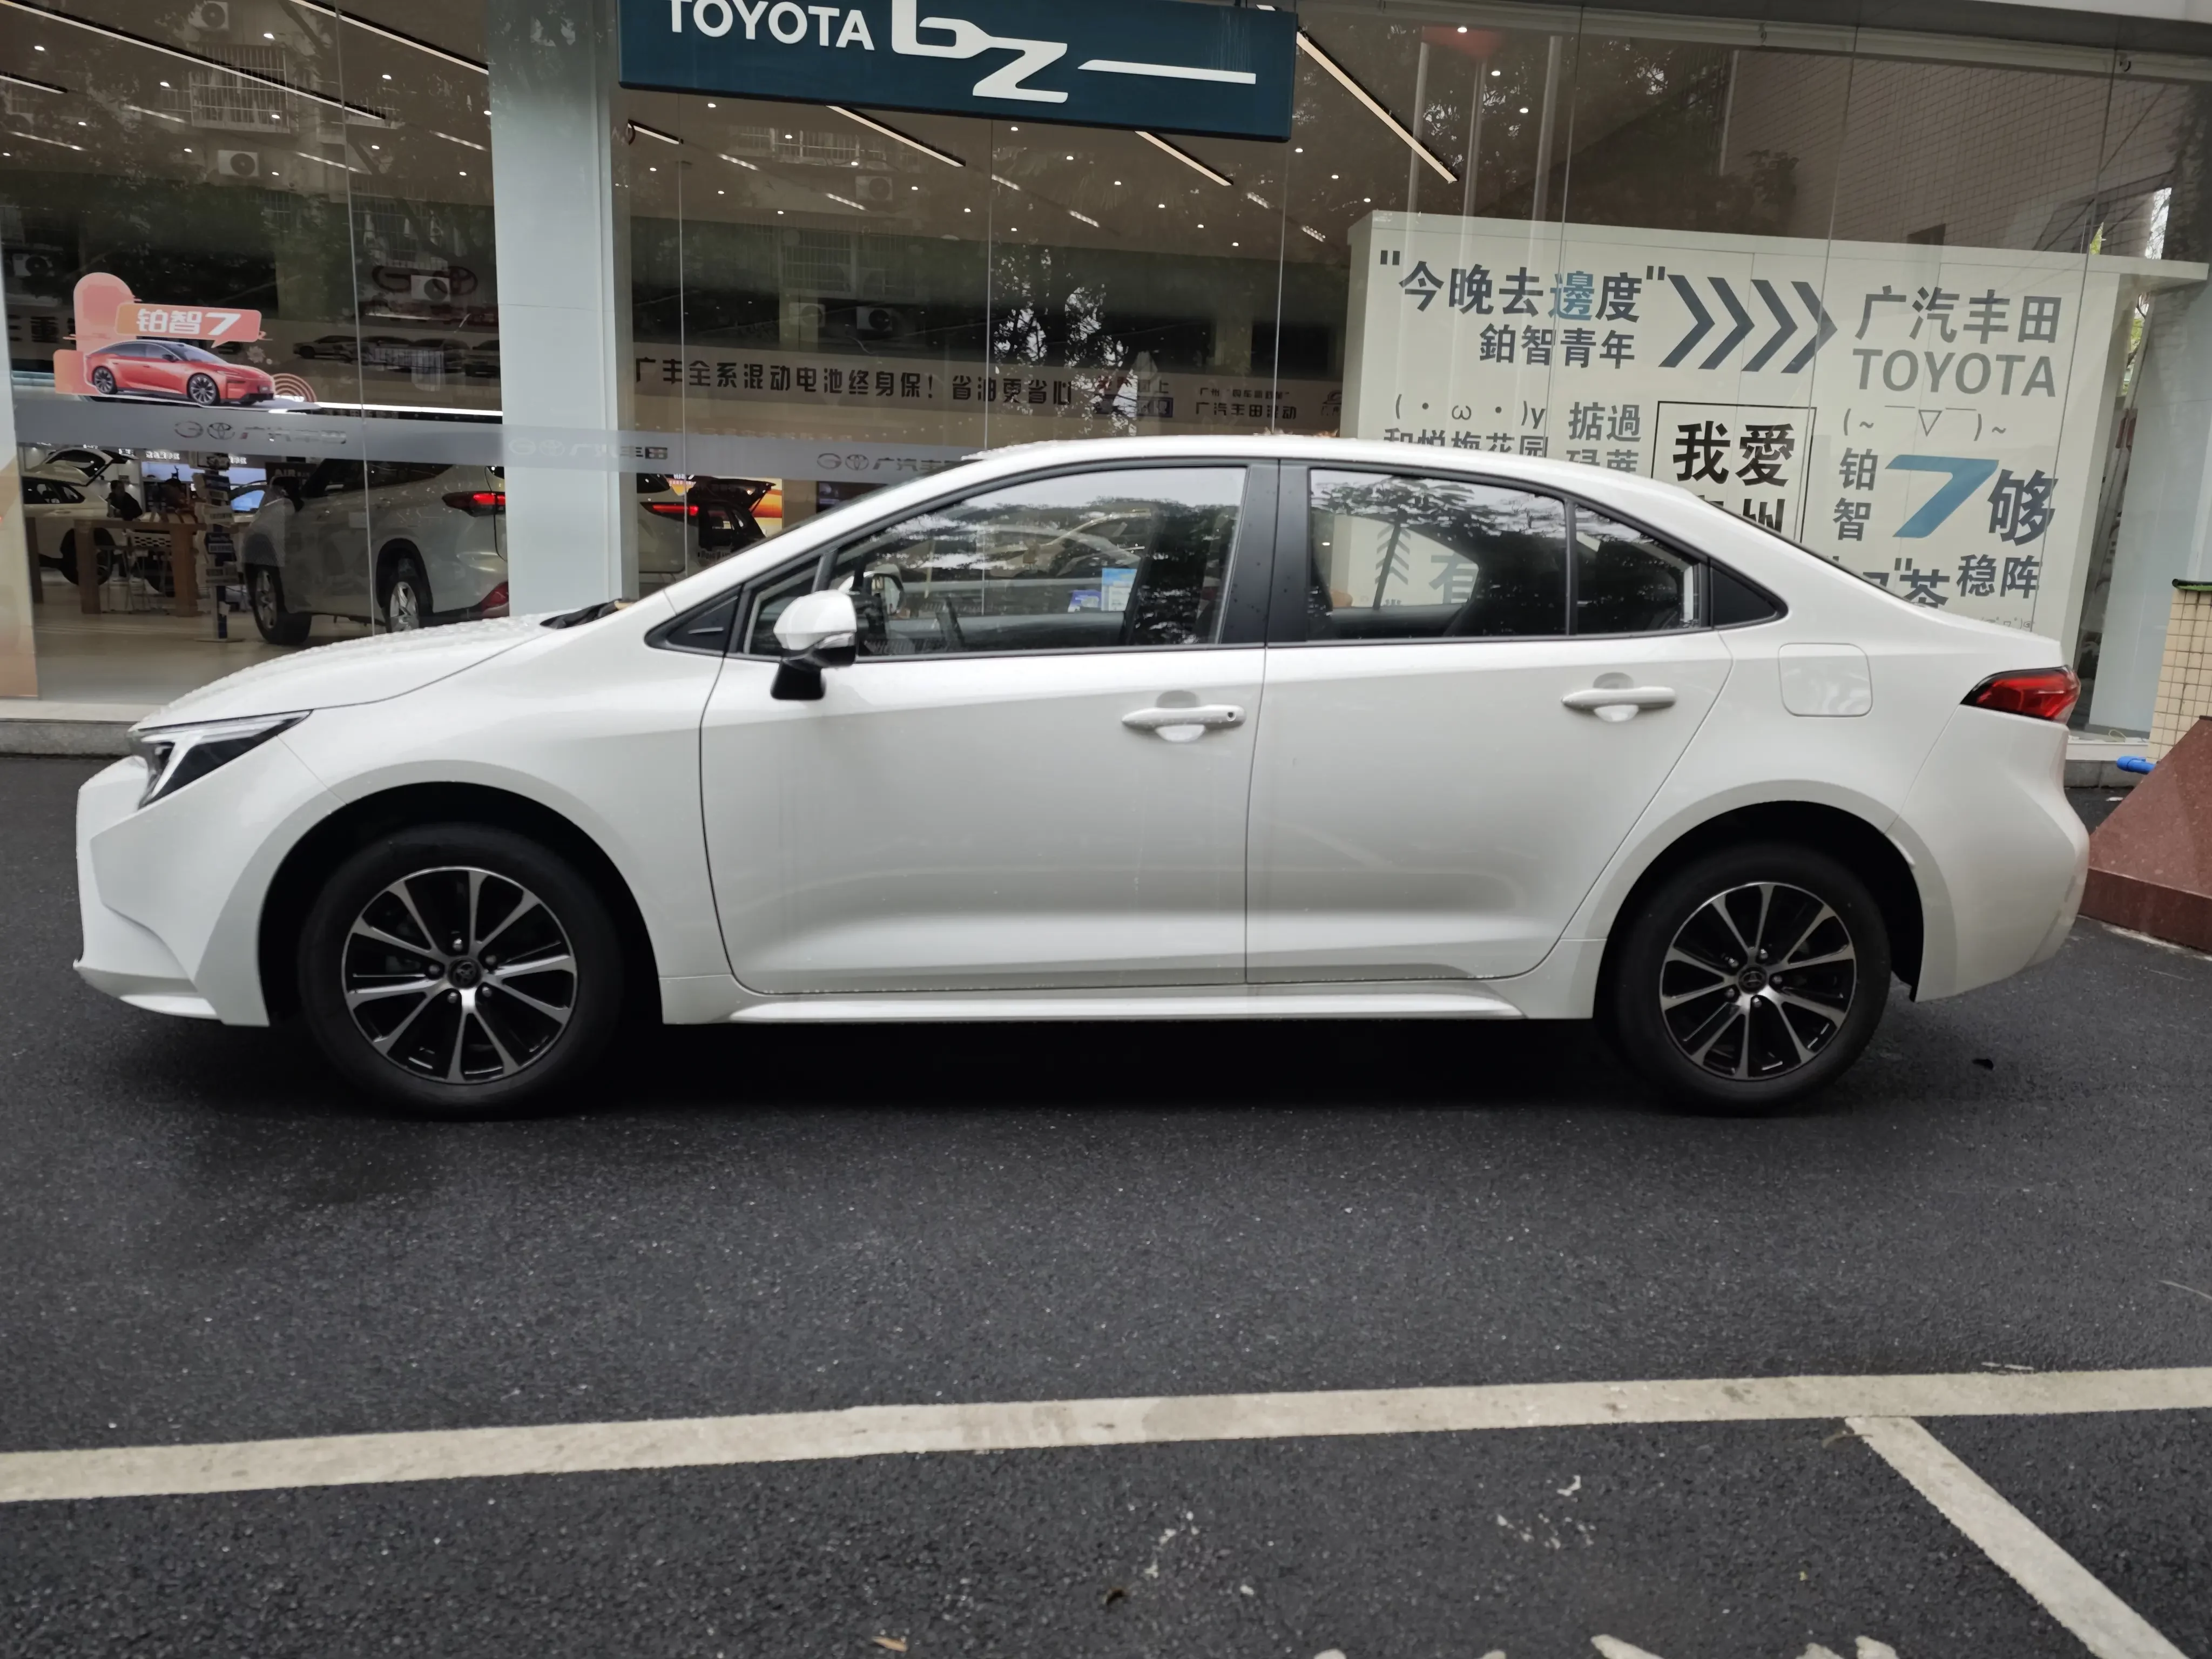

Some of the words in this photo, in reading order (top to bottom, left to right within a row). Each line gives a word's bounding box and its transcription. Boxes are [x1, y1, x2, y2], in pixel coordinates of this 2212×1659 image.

[670, 0, 875, 51] TOYOTA
[136, 308, 241, 336] 铂智7
[1854, 285, 2062, 344] 广汽丰田
[1479, 323, 1635, 369] 鉑智青年
[1852, 348, 2056, 397] TOYOTA
[1673, 420, 1796, 487] 我愛
